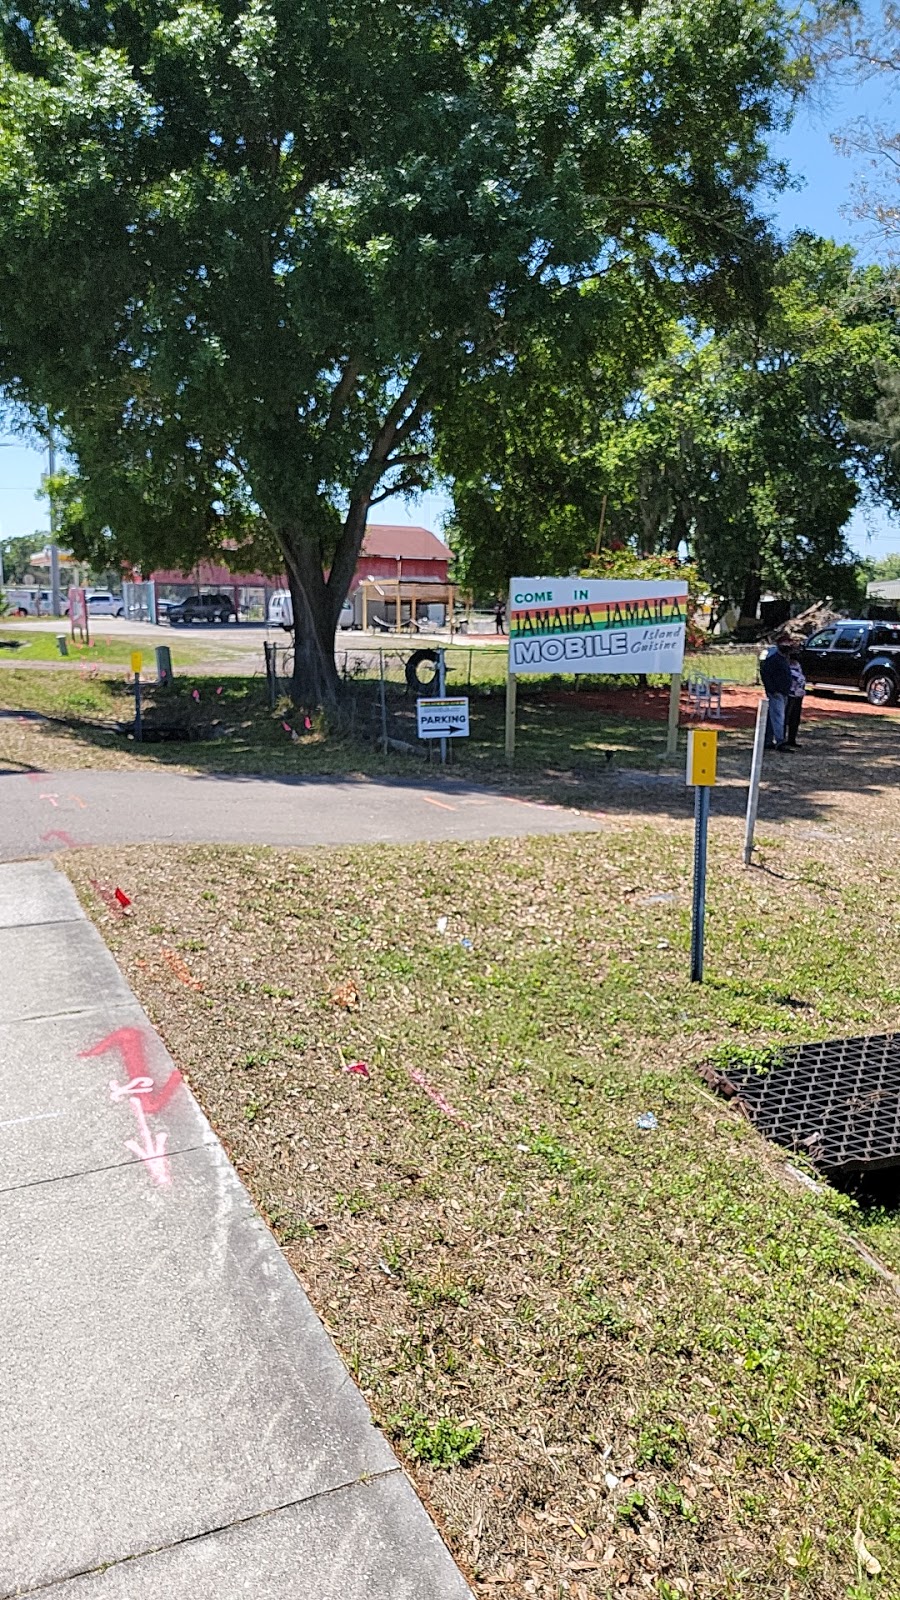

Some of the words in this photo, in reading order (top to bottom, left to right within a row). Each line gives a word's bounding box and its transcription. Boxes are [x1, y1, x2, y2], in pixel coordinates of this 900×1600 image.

[514, 591, 553, 604] COME
[574, 590, 589, 601] IN
[514, 605, 596, 638] JAMAICA
[605, 598, 683, 629] JAMAICA
[642, 626, 682, 641] Island
[514, 632, 628, 665] MOBILE
[630, 640, 677, 654] Cuisine
[420, 715, 467, 725] PARKING
